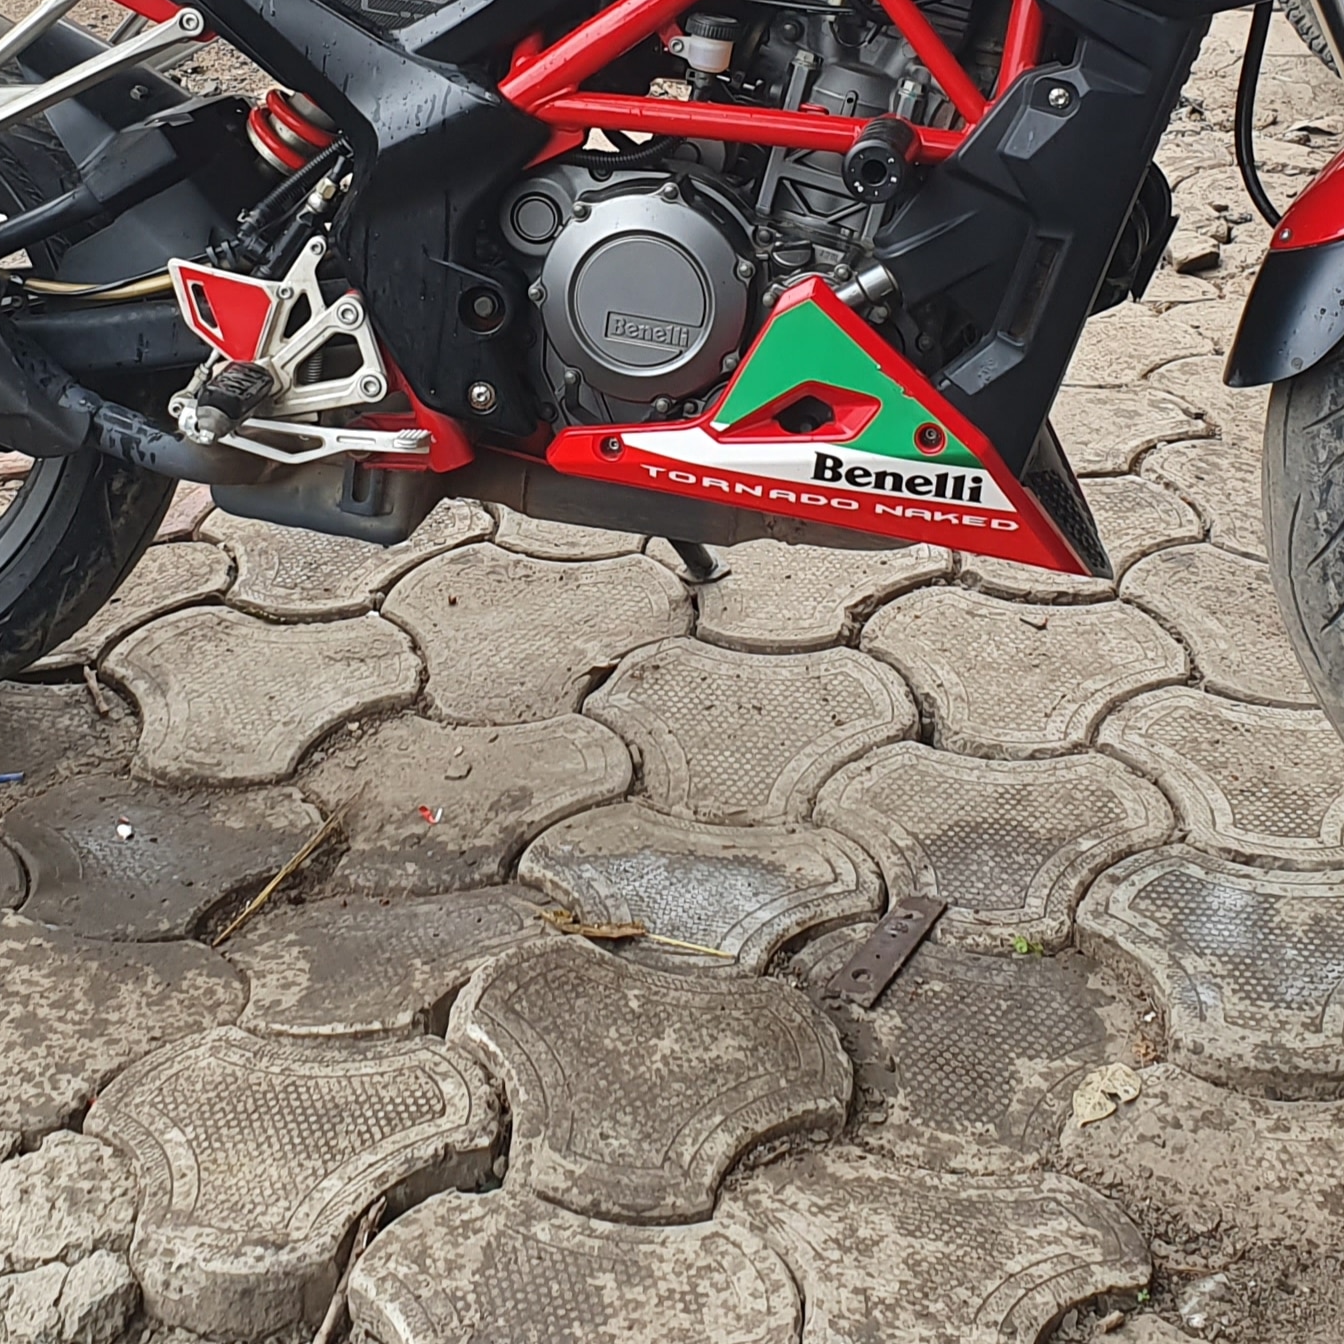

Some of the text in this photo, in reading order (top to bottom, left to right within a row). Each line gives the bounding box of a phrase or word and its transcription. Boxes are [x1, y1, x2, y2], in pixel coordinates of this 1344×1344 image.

[610, 318, 690, 347] Benelli
[639, 463, 1020, 532] TORNADO NAKED
[811, 451, 983, 504] Benelli
